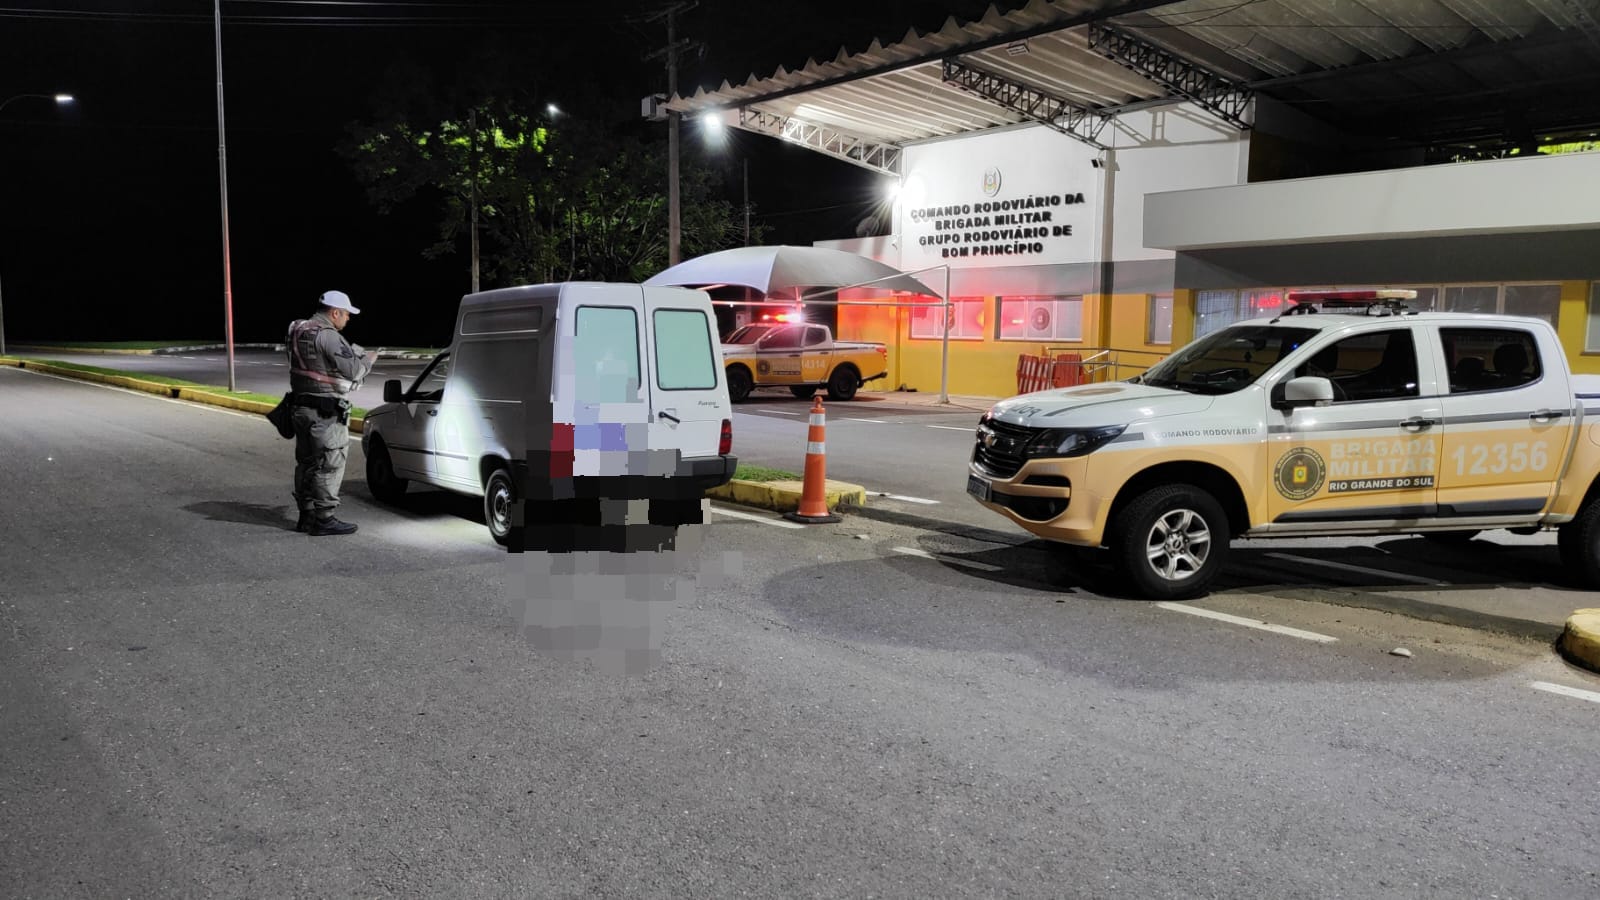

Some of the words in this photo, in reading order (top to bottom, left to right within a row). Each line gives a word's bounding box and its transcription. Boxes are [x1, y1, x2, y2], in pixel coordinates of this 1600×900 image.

[910, 204, 971, 220] COMANDO
[974, 195, 1061, 213] RODOVIÁRIO
[1065, 193, 1085, 205] DA
[935, 216, 991, 231] BRIGADA
[994, 211, 1052, 226] MILITAR
[919, 230, 961, 246] GRUPO
[964, 225, 1049, 243] RODOVIÁRIO
[1053, 225, 1072, 237] DE
[942, 246, 969, 259] BOM
[973, 241, 1043, 257] PRINCÍPIO
[1154, 430, 1201, 439] COMANDO
[1330, 439, 1436, 459] BRIGADA
[1452, 440, 1548, 476] 12356
[1329, 457, 1435, 477] MILITAR
[1329, 481, 1348, 491] RIO
[1350, 478, 1393, 490] GRANDE
[1396, 477, 1410, 487] DO
[1414, 476, 1433, 486] SUL
